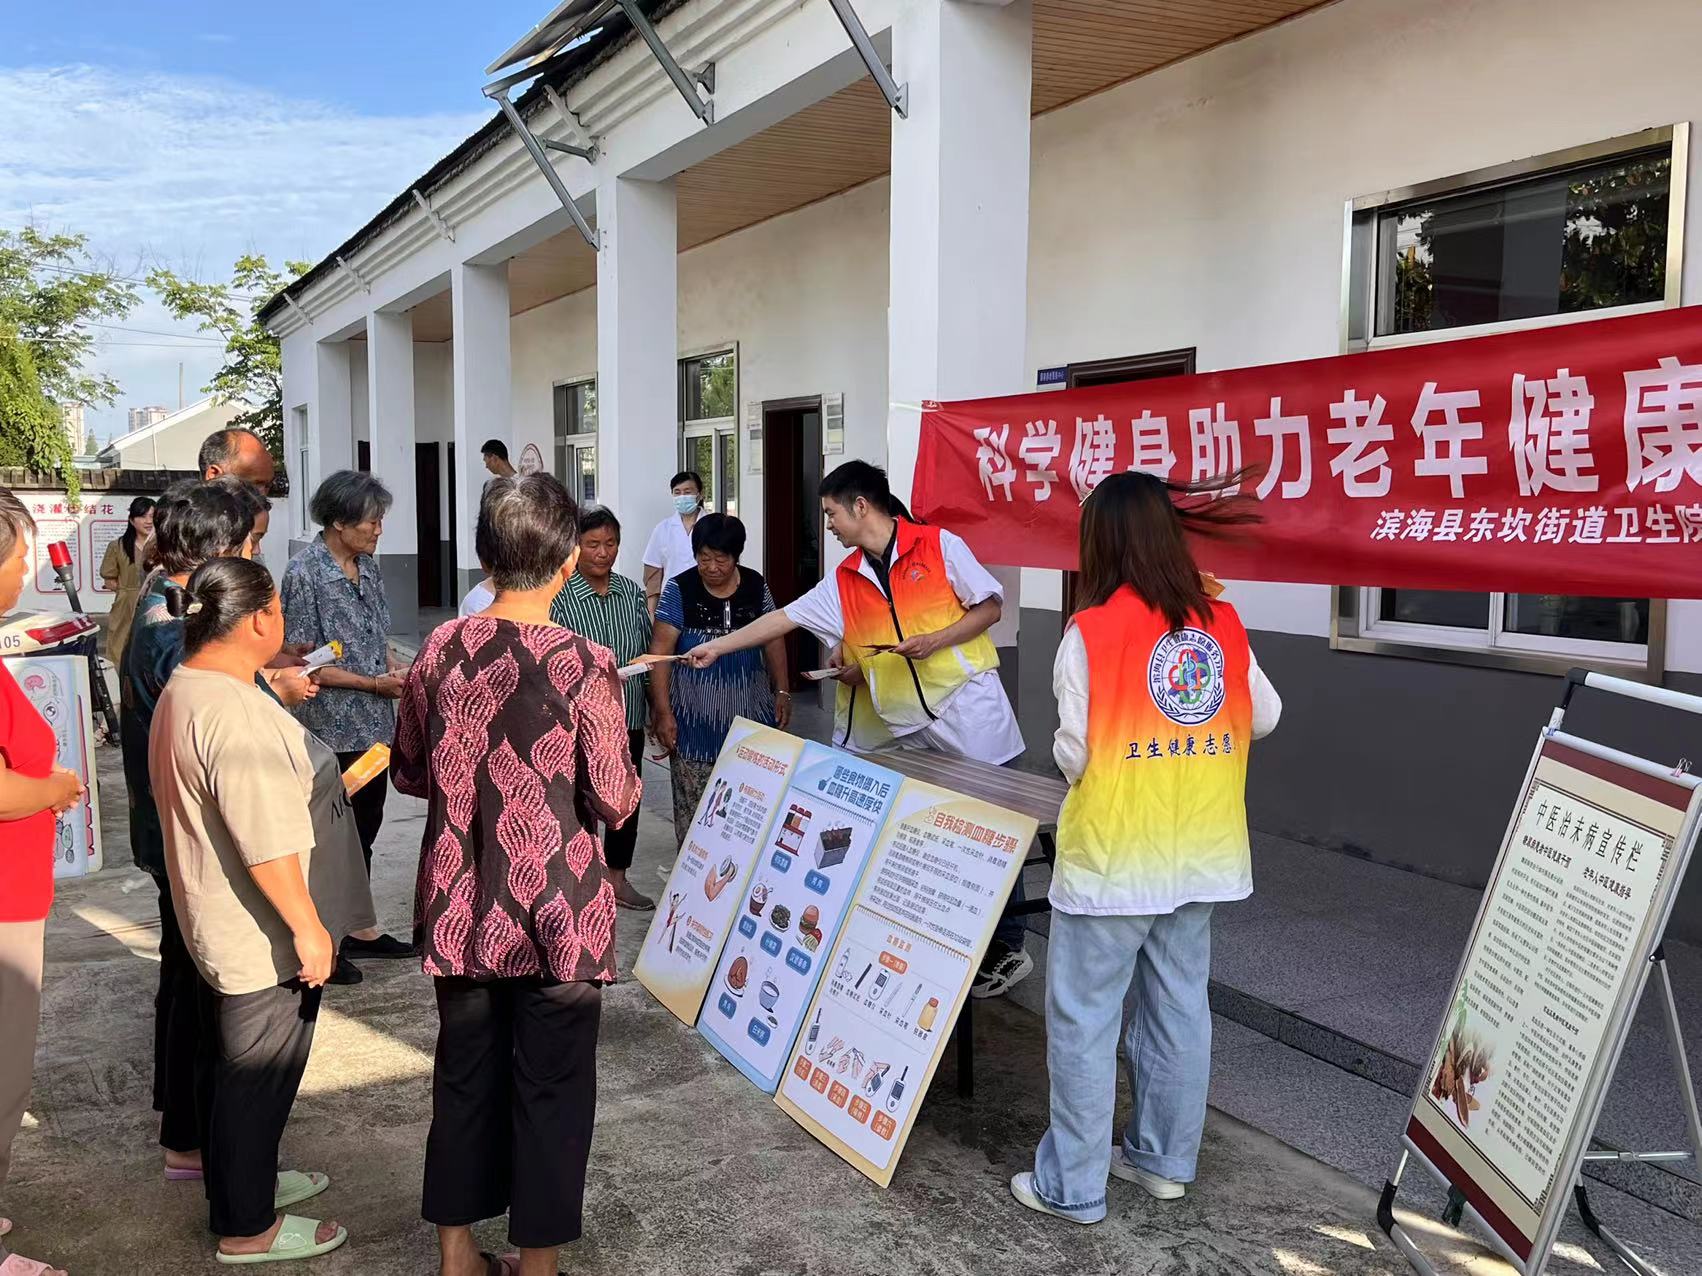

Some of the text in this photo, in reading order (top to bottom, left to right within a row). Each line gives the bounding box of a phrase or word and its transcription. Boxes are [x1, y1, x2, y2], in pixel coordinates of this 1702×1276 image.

[973, 356, 1702, 502] 科学健身助力老年健康
[1370, 502, 1702, 544] 滨海县东坎街道卫生院
[0, 635, 20, 648] 05
[1125, 733, 1233, 760] 卫生健康志愿
[1536, 799, 1644, 873] 中医治未病宣传栏
